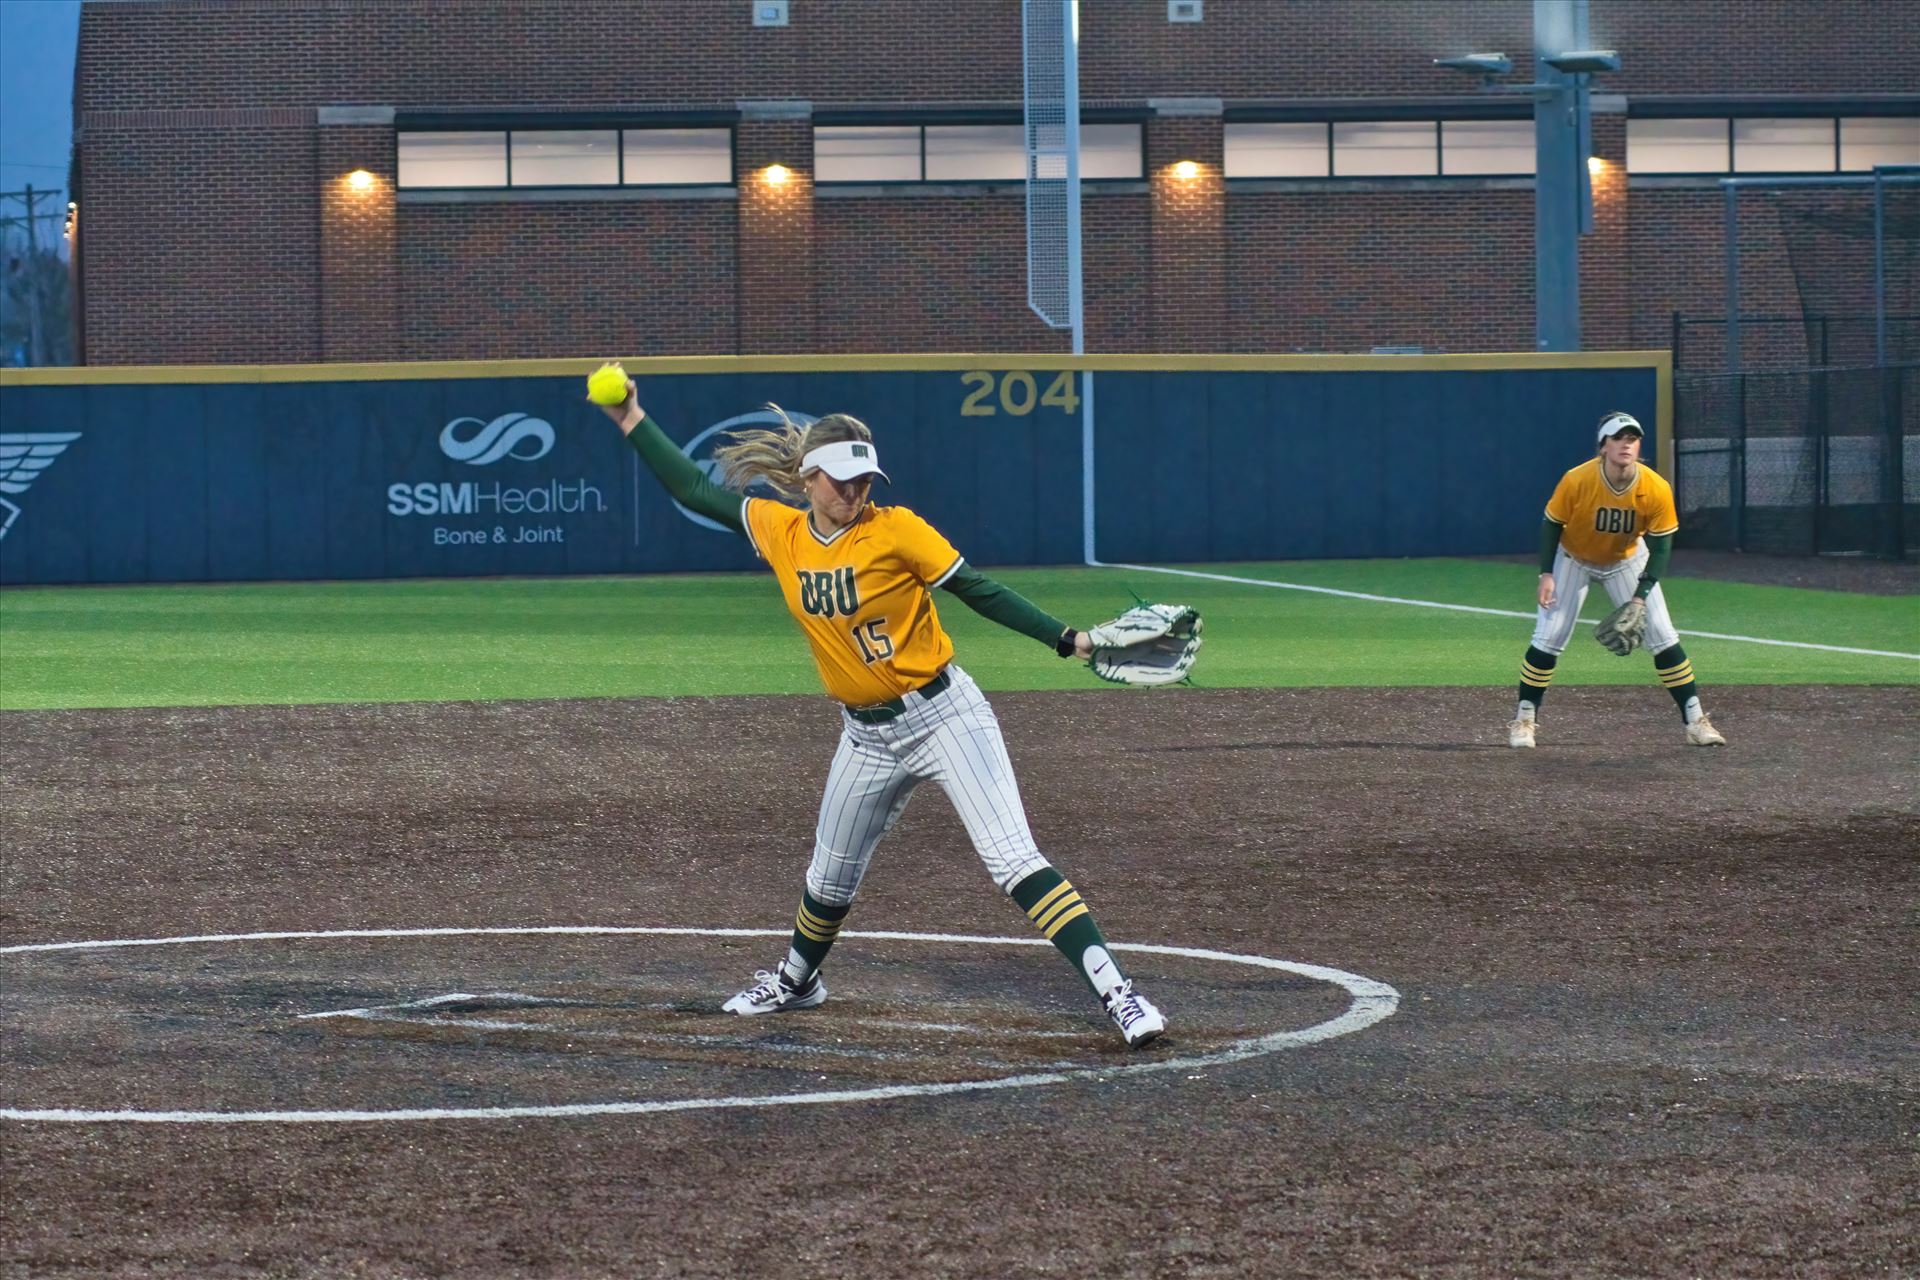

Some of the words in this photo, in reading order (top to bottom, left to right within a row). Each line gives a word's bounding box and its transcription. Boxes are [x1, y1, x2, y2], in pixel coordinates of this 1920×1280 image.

[961, 370, 1080, 416] 204
[433, 527, 487, 545] Bone
[492, 526, 507, 544] &
[513, 525, 564, 544] Joint
[1595, 506, 1636, 534] OBU
[796, 566, 860, 618] OBU
[852, 616, 895, 665] 15
